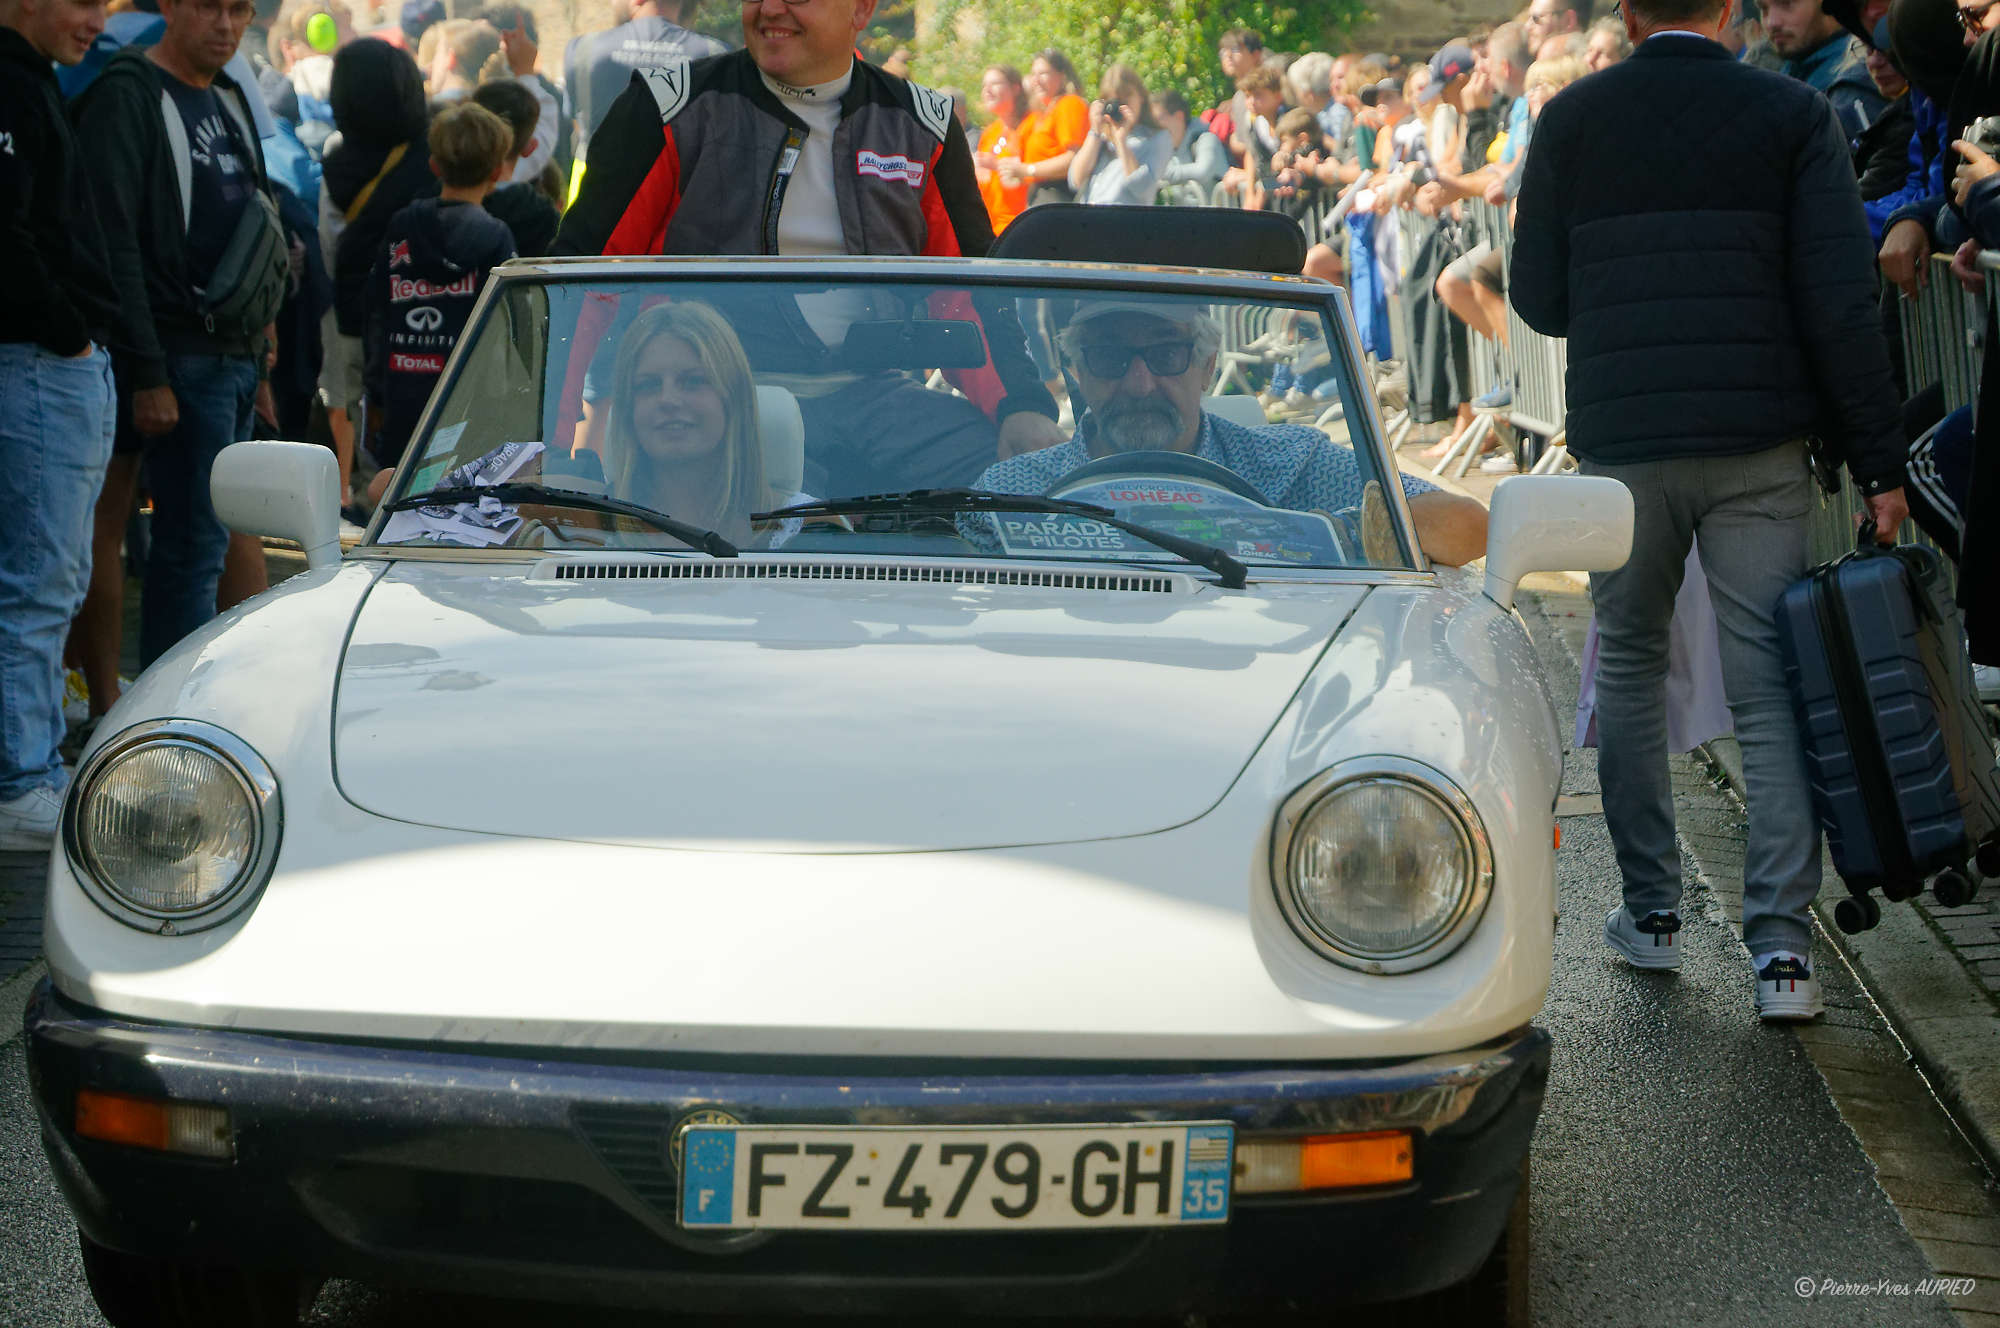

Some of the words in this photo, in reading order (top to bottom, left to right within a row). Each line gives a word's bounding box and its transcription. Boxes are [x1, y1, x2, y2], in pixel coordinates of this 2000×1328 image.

[394, 354, 441, 369] TOTAL
[1005, 521, 1120, 537] PARADE
[1030, 535, 1125, 549] PILOTES
[747, 1140, 1175, 1219] FZ-479-GH
[698, 1189, 715, 1212] F
[1185, 1179, 1225, 1212] 35
